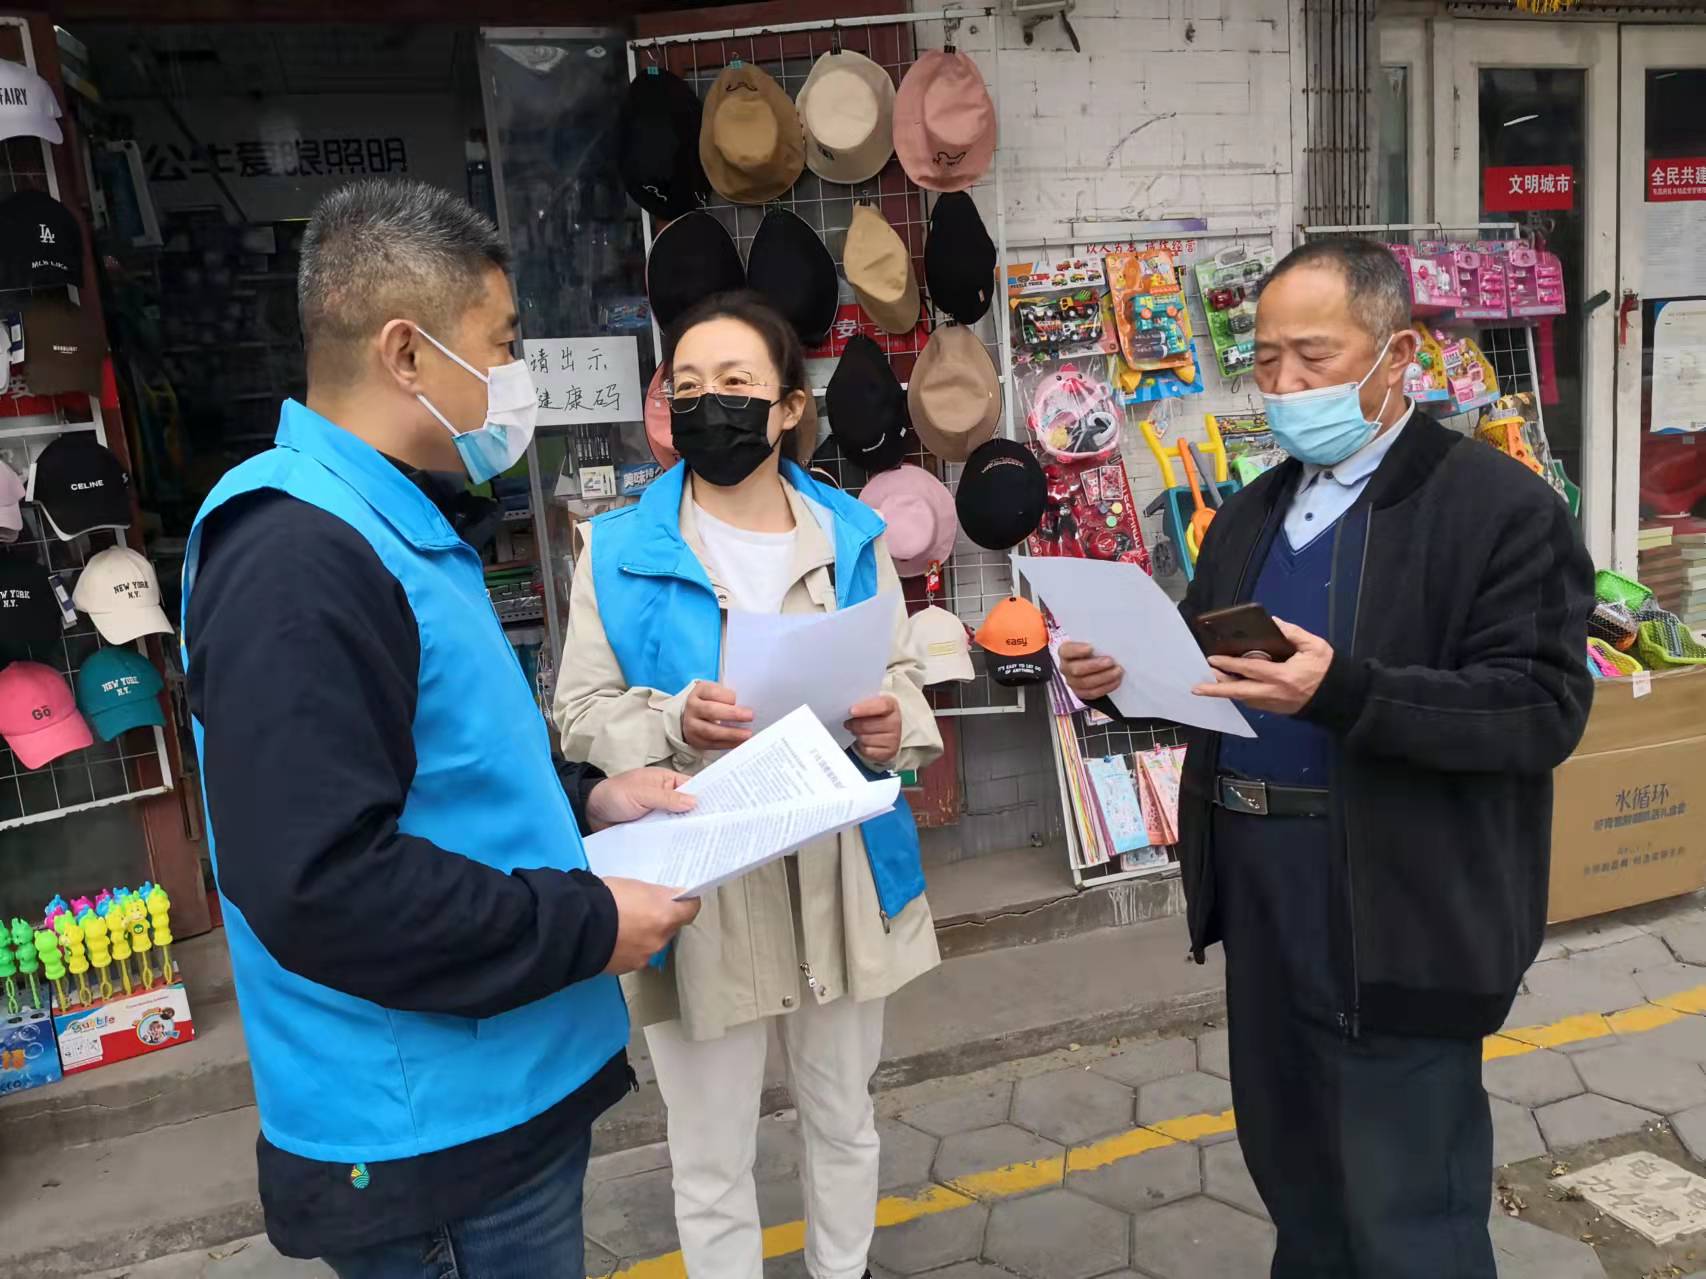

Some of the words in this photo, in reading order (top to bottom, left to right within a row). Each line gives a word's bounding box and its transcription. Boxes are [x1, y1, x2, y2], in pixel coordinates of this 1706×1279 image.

[1508, 173, 1571, 195] 文明城市
[39, 223, 56, 244] LA
[530, 347, 608, 374] 请出示
[71, 480, 104, 491] CELINE
[10, 590, 31, 600] YORK
[113, 582, 130, 594] NEW
[132, 581, 149, 589] YORK
[101, 679, 119, 692] NEW
[120, 676, 140, 686] YORK
[1616, 783, 1670, 813] 水循环
